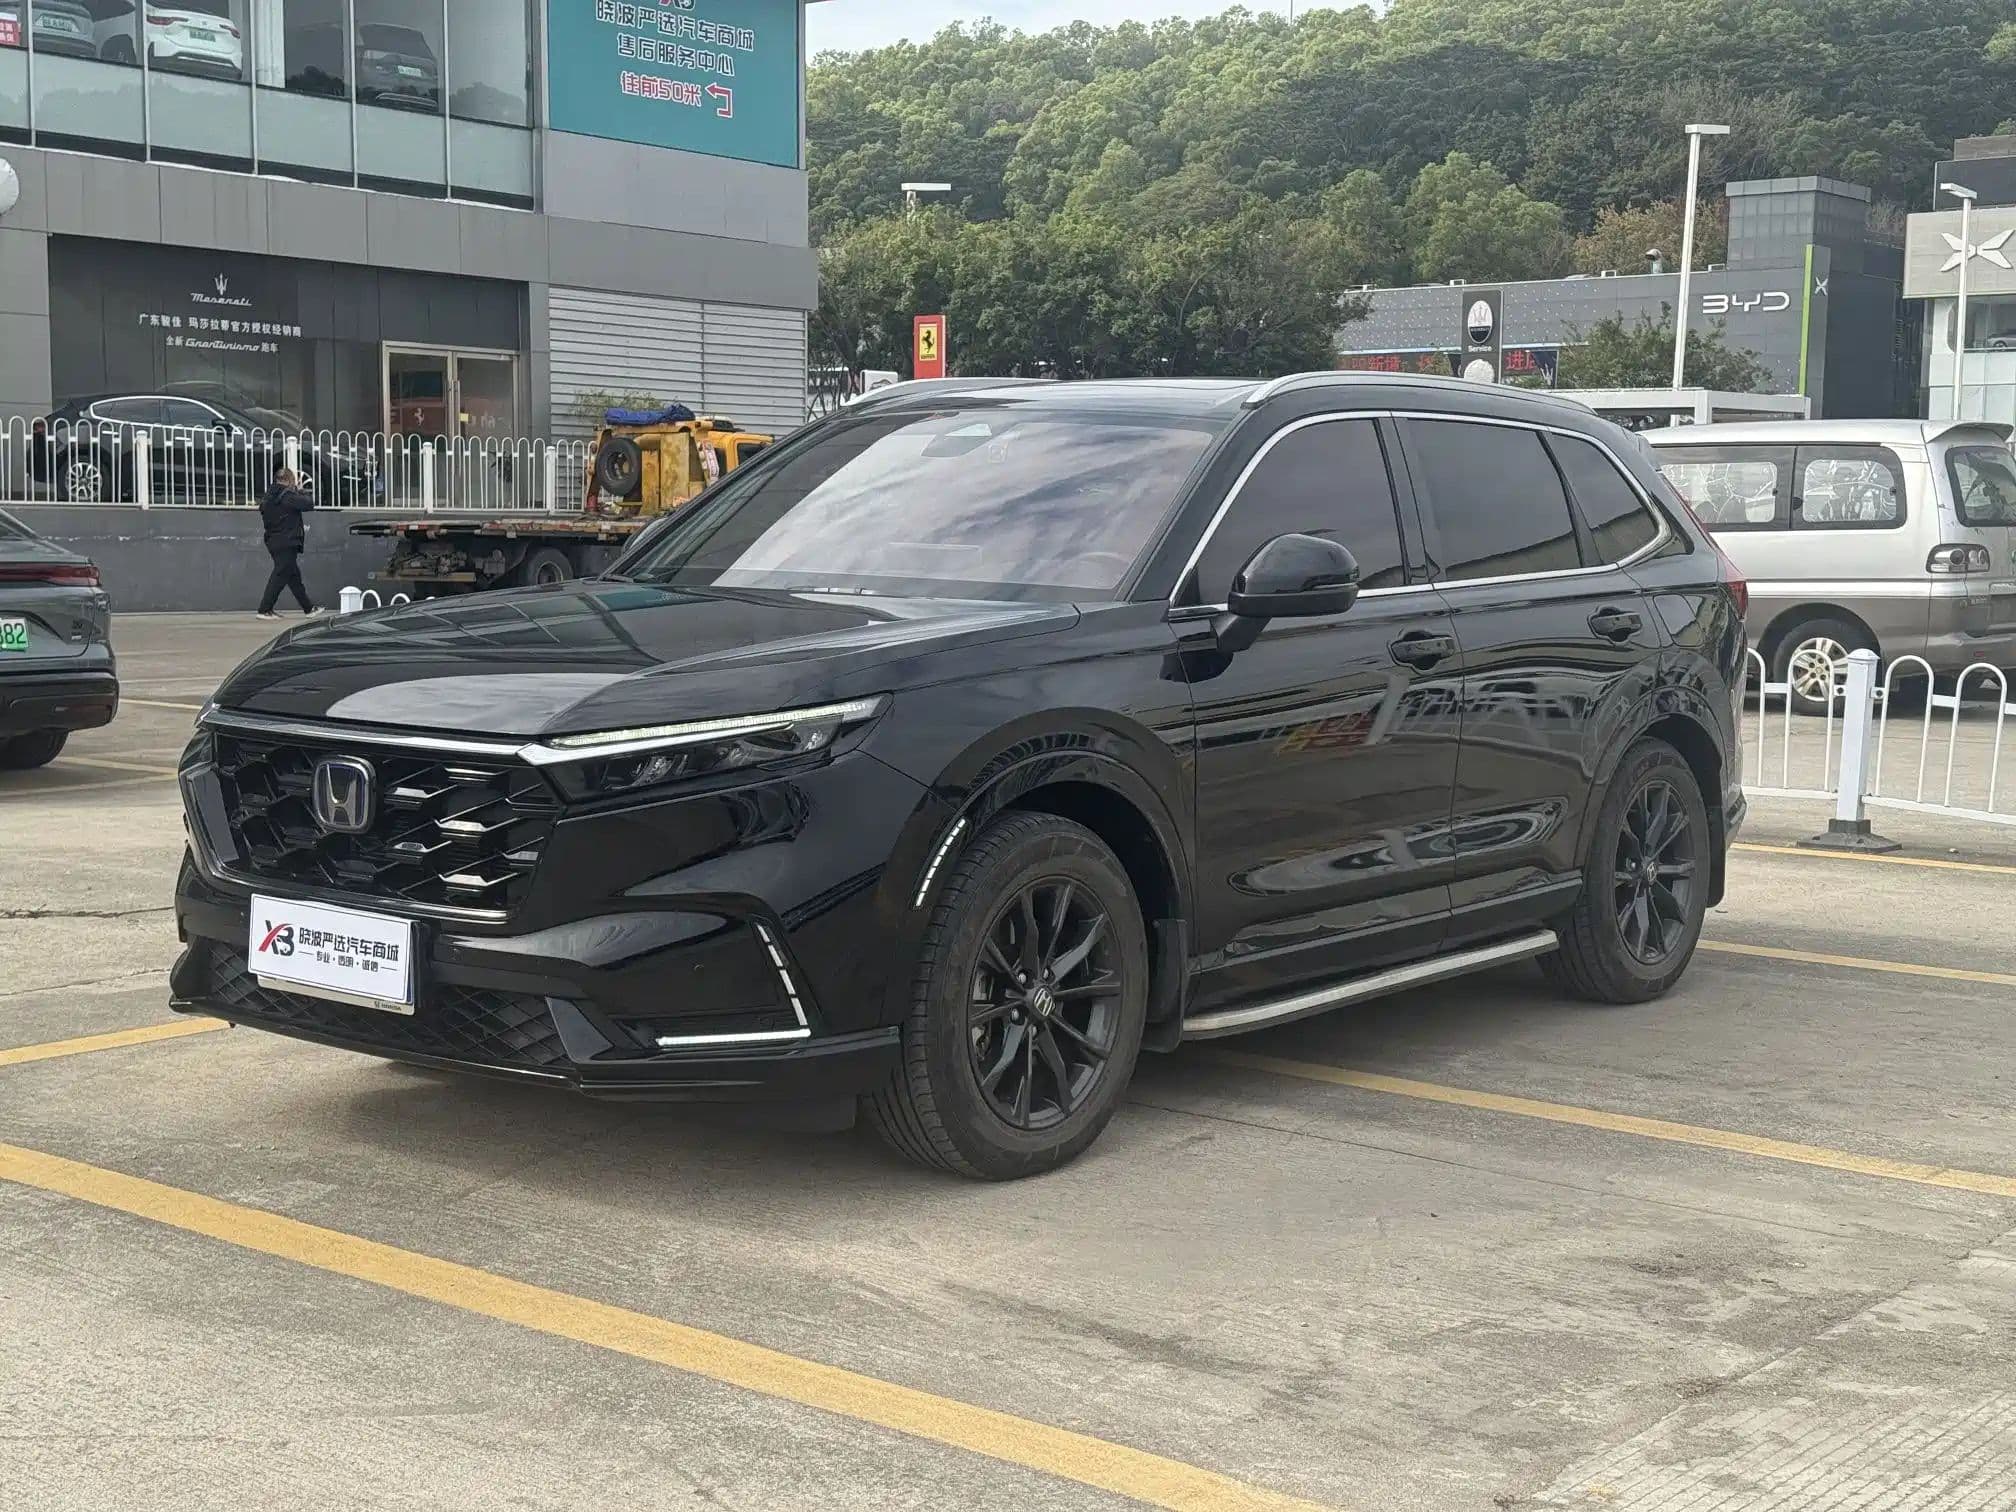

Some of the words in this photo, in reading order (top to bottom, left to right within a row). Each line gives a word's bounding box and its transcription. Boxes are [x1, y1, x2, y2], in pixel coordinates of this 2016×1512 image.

[596, 1, 754, 51] 晓波严选汽车商城
[617, 33, 735, 76] 售后服务中心
[190, 292, 252, 306] Maserati
[1702, 291, 1790, 314] BYD
[166, 335, 183, 347] 全新
[299, 927, 400, 962] 晓波严选汽车商城
